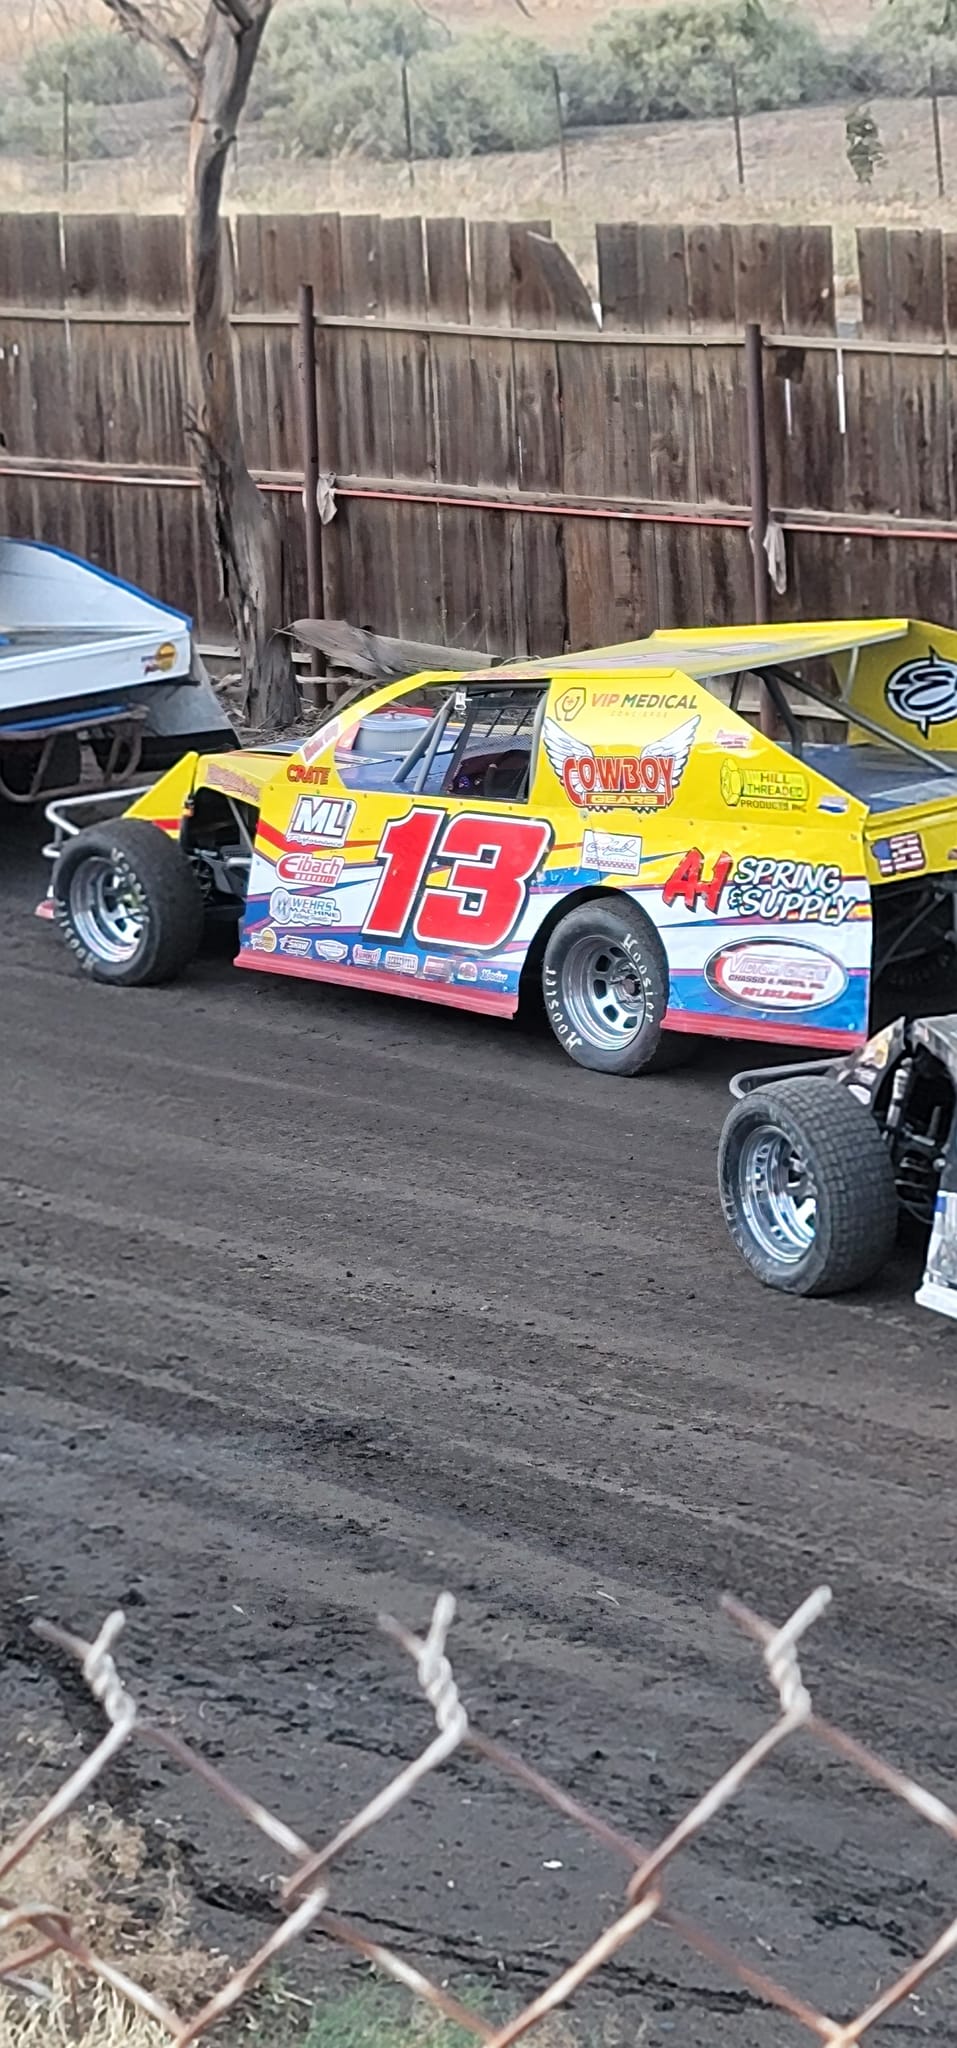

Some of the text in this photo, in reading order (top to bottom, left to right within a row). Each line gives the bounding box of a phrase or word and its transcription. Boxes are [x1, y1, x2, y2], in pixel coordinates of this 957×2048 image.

[591, 693, 698, 710] VIP MEDICAL
[286, 764, 331, 785] CRATE
[562, 755, 676, 807] COWBOY
[760, 773, 792, 784] HILL
[590, 794, 659, 806] GEARS
[746, 784, 803, 797] THREADED
[740, 799, 790, 811] PRODUCTS
[291, 798, 346, 837] ML
[277, 854, 340, 883] Eibach
[360, 803, 556, 952] 13
[733, 855, 842, 894] SPRING
[288, 907, 339, 918] MACHINE
[291, 898, 333, 912] WEHRS
[739, 887, 859, 926] SUPPLY
[621, 933, 654, 1023] Hoosier
[728, 974, 767, 984] CHASSIS
[545, 965, 583, 1050] Hoosier
